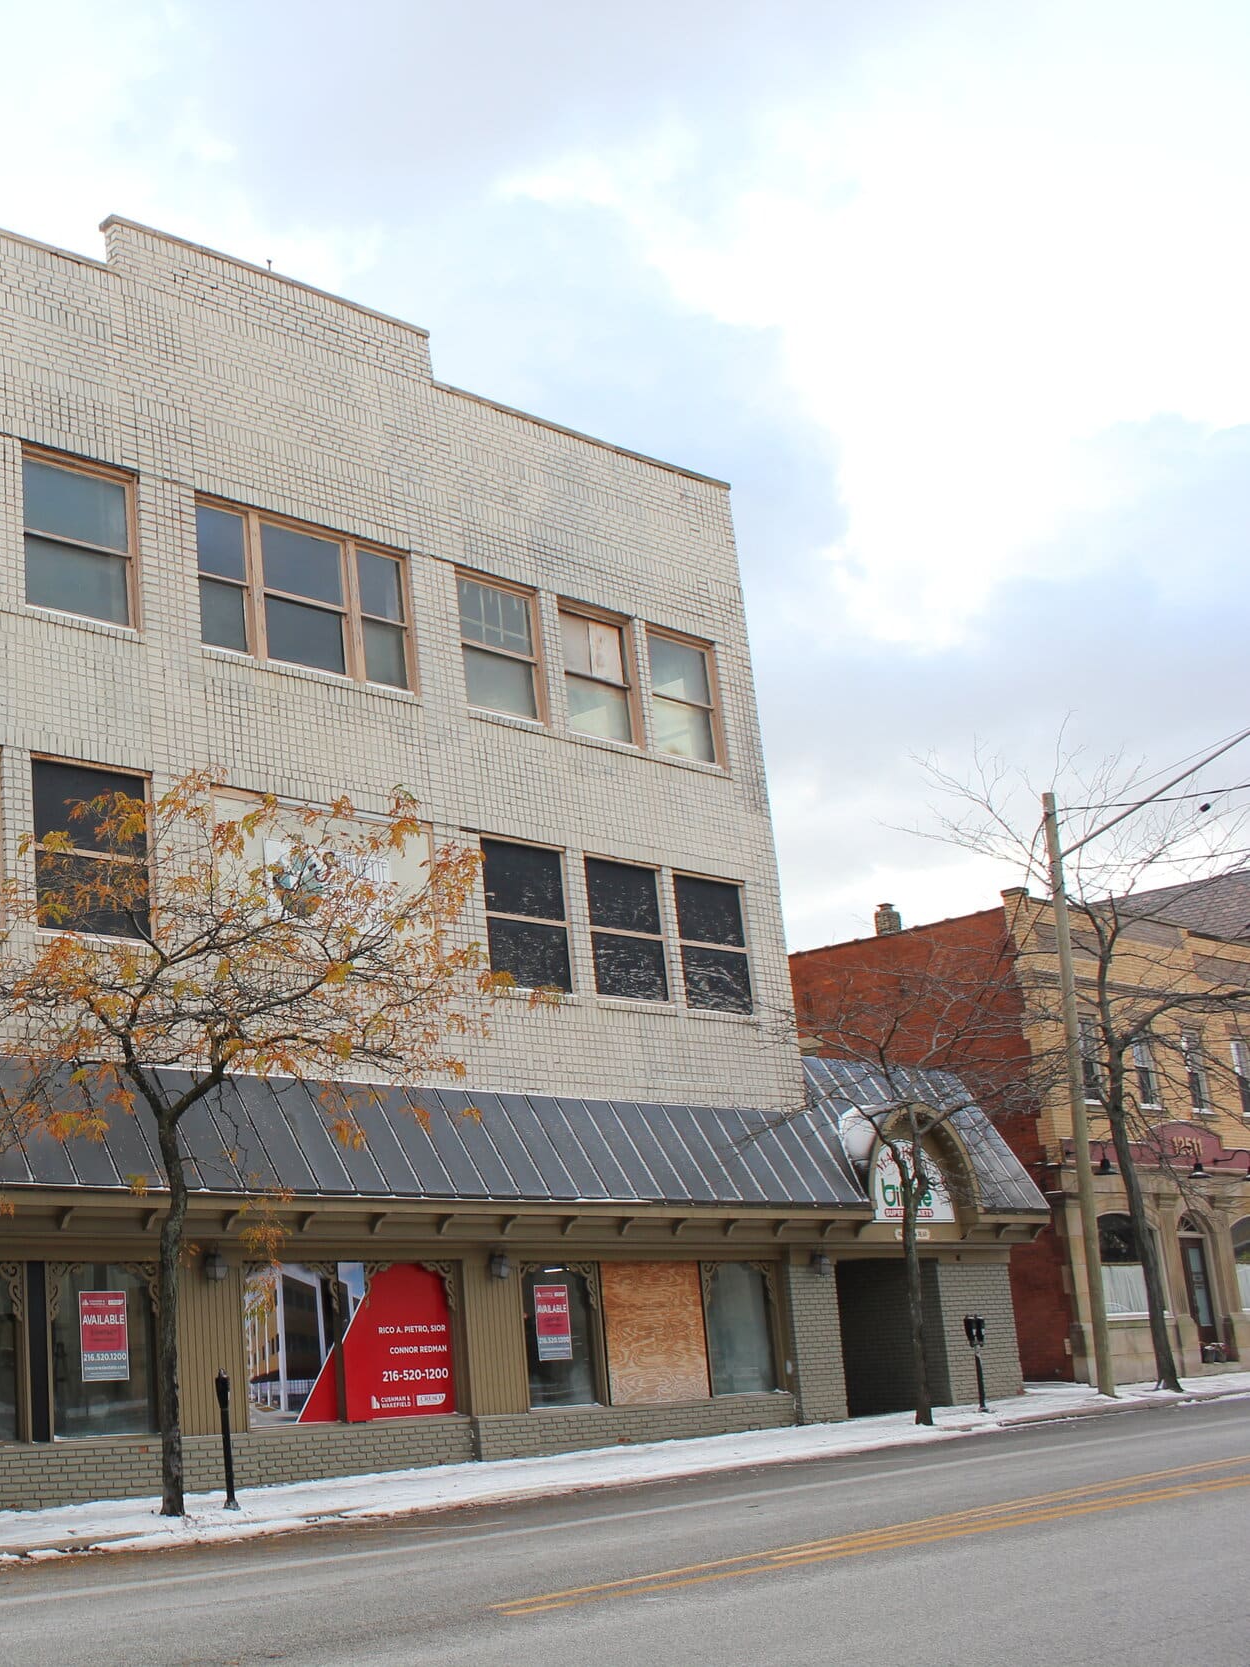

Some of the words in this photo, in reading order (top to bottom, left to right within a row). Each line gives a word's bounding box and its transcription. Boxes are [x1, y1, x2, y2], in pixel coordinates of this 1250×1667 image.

[1172, 1136, 1202, 1156] 12511
[537, 1304, 567, 1313] AVAILABLE
[82, 1314, 125, 1325] AVAILABLE
[404, 1325, 430, 1333] PIETRO,
[390, 1346, 419, 1354] CONNOR
[419, 1345, 447, 1353] REDMAN
[83, 1352, 127, 1361] 216.520.1200
[382, 1368, 449, 1382] 216-520-1200
